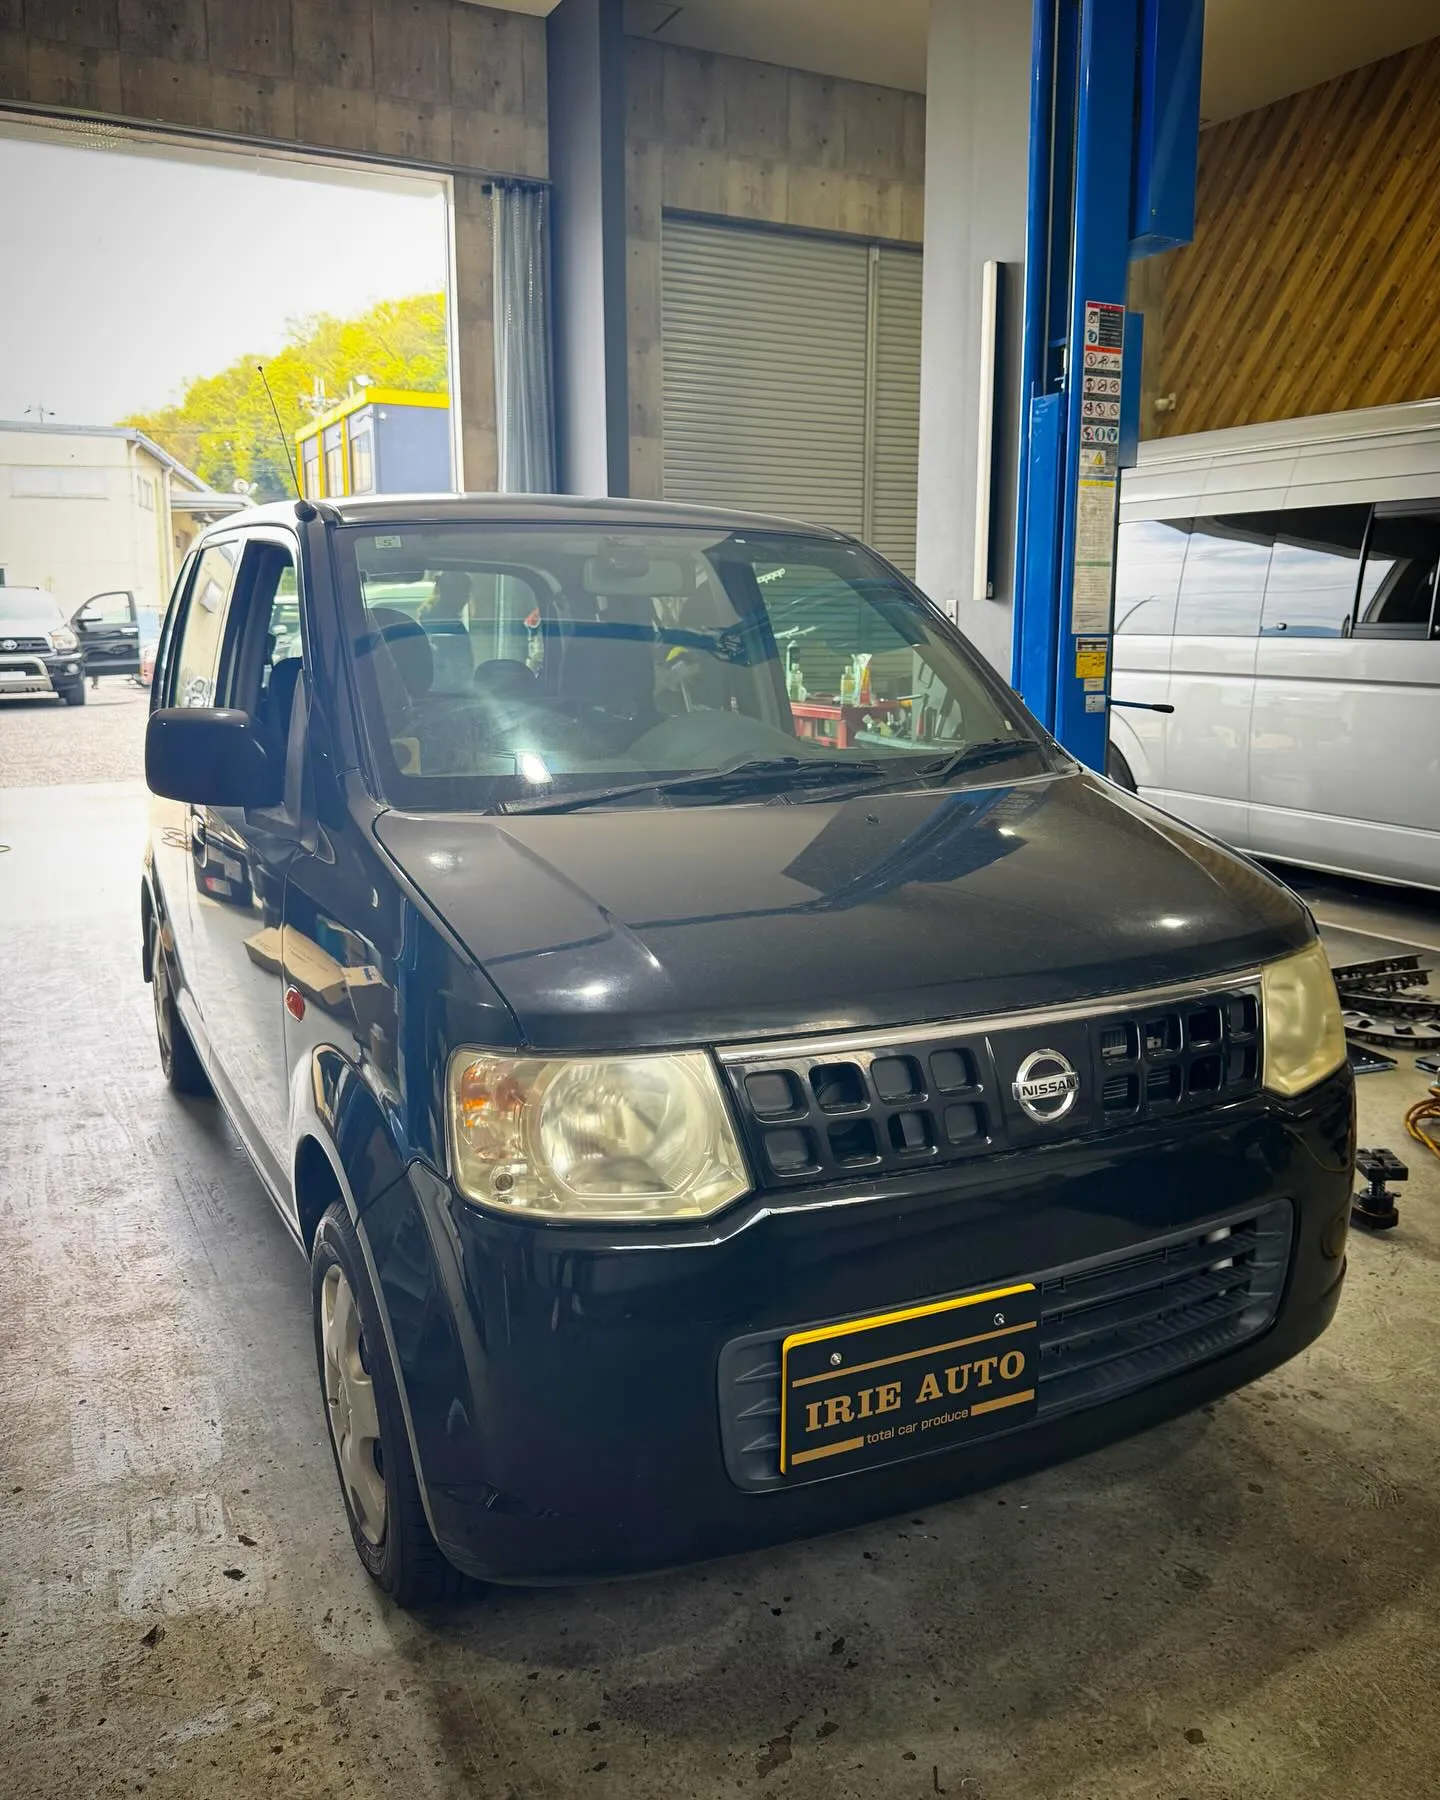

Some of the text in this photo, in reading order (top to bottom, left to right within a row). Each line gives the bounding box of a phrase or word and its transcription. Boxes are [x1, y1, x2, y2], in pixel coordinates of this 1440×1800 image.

[1021, 1078, 1076, 1096] NISSAN
[804, 1350, 1026, 1432] IRIE AUTO
[866, 1409, 969, 1444] total car produce
